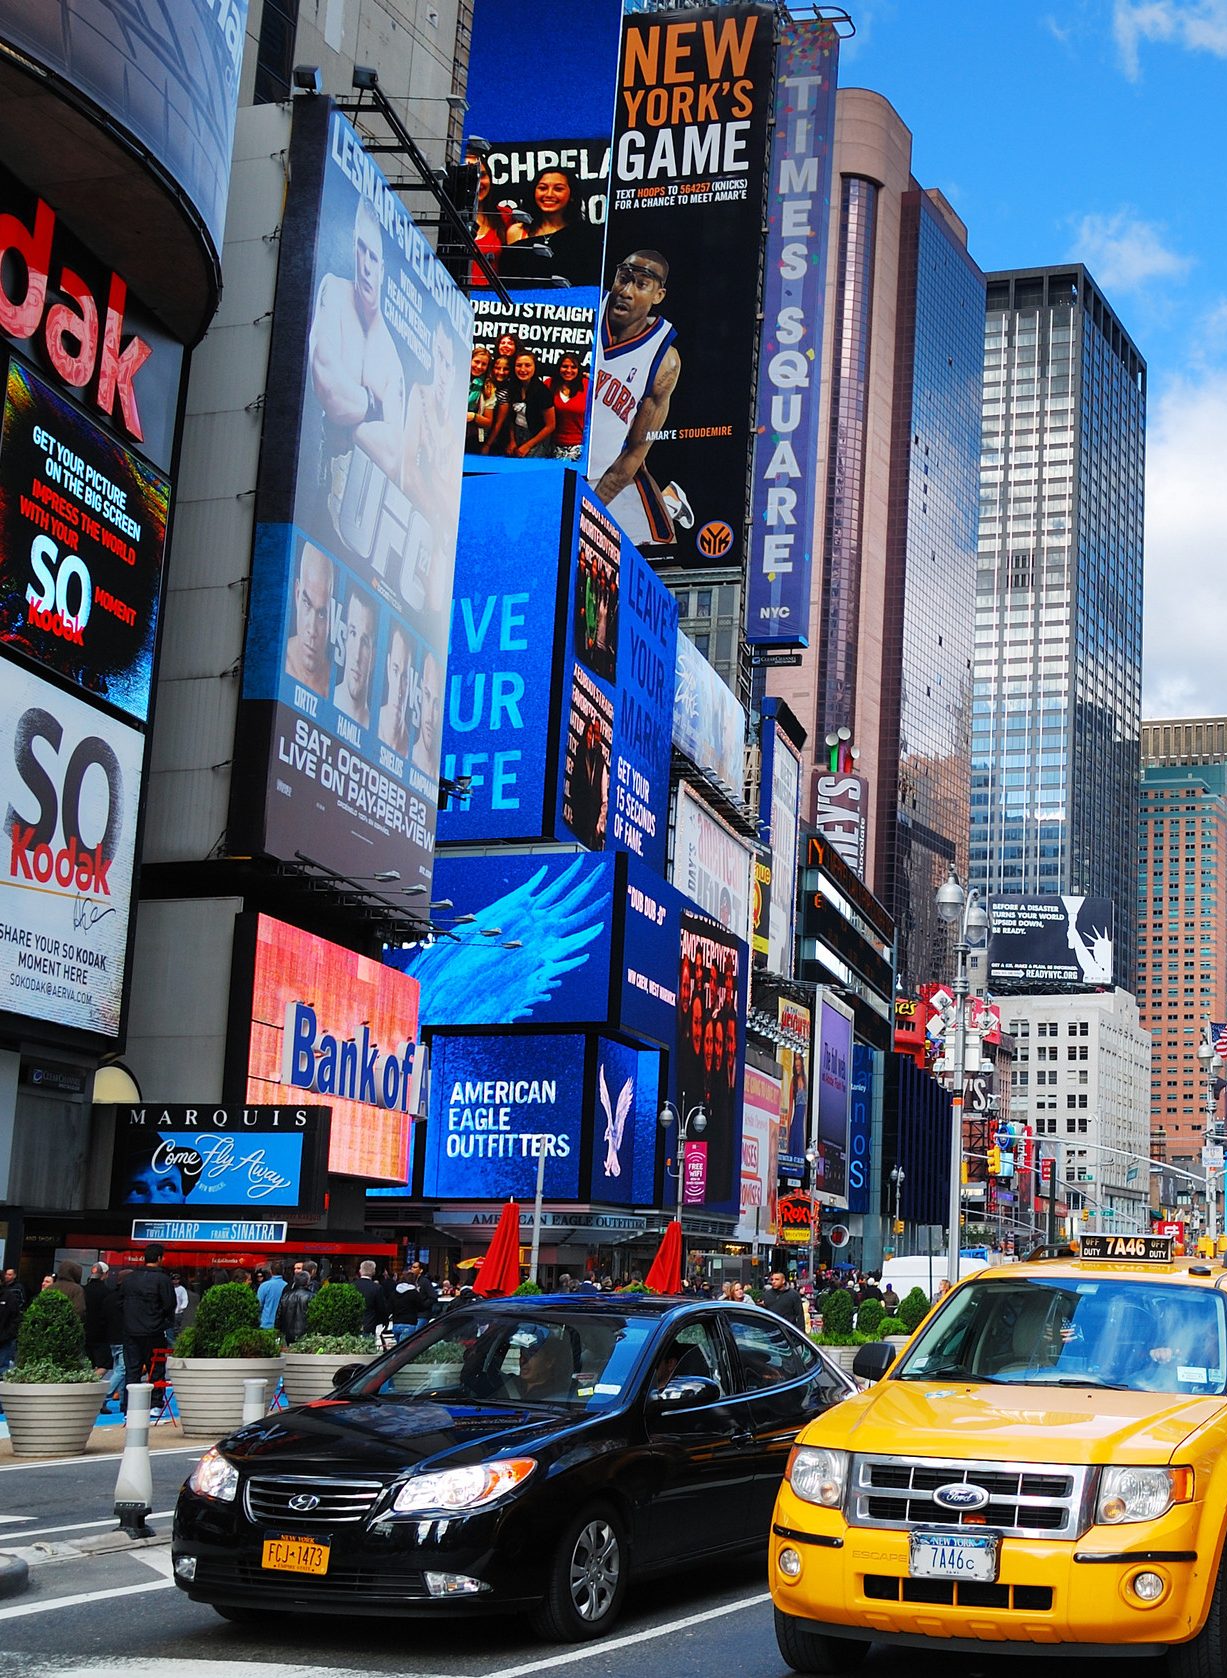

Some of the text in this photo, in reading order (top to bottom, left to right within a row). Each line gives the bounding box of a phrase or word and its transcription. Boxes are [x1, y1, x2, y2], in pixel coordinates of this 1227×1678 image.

[623, 16, 759, 87] NEW
[623, 79, 753, 128] YORK'S
[617, 120, 751, 181] GAME
[331, 115, 394, 239] LESNAR
[615, 190, 748, 210] FOR A CHANCE TO MEET AMAR'E
[616, 179, 748, 199] TEXT HOOPS TO 564257 (KNICKS)
[779, 75, 822, 280] TIMES
[400, 269, 422, 313] WORLD
[403, 216, 473, 348] VELASQUEZ
[387, 277, 432, 349] HEAVYWEIGHT
[595, 369, 637, 425] YORK
[645, 425, 733, 441] AMAR'E STOUDEMIRE
[762, 306, 810, 574] SQUARE
[32, 425, 128, 511] GET YOUR PICTURE
[32, 479, 136, 567] IMPRESS THE WORLD
[45, 458, 141, 543] ON THE BIG SCREEN
[19, 496, 79, 552] WITH YOUR
[26, 534, 91, 631] SO
[628, 556, 667, 648] LEAVE
[27, 596, 85, 647] Kodak
[95, 586, 137, 627] MOMENT
[760, 606, 790, 619] NYC
[330, 598, 346, 668] VS
[630, 627, 665, 702] YOUR
[294, 684, 319, 719] ORTIZ
[409, 663, 423, 728] VS
[450, 671, 525, 733] UR
[336, 714, 361, 749] HAMILL
[619, 687, 664, 762] MARK
[278, 737, 316, 780] LIVE
[320, 765, 345, 798] ON
[294, 718, 332, 763] SAT.
[337, 750, 406, 810] OCTOBER
[409, 797, 427, 827] 23
[379, 745, 404, 779] SHIELDS
[618, 756, 650, 804] GET YOUR
[3, 707, 124, 866] SO
[613, 813, 644, 857] OF FAME.
[616, 786, 656, 838] 15 SECONDS
[10, 823, 111, 895] Kodak
[992, 903, 1019, 911] BEFORE
[1028, 904, 1060, 913] DISASTER
[992, 911, 1065, 921] TURNS YOUR WORLD
[992, 919, 1044, 929] UPSIDE DOWN,
[0, 923, 107, 971] SHARE YOUR SO KODAK
[1002, 928, 1027, 936] READY.
[10, 973, 92, 1005] SOKODAK@AERVA.COM
[18, 950, 89, 986] MOMENT HERE
[1026, 969, 1078, 980] READYNYC.ORG
[286, 1001, 415, 1112] Bank of
[449, 1080, 557, 1105] AMERICAN
[130, 1109, 308, 1126] MARQUIS
[448, 1107, 511, 1131] EAGLE
[151, 1134, 292, 1199] Come Fly Away
[446, 1133, 571, 1158] OUTFITTERS
[688, 1163, 704, 1171] FREE
[146, 1221, 276, 1241] TWYLA THARP FRANK SINATRA
[552, 1215, 646, 1229] EAGLE OUTFITTERS
[1083, 1247, 1167, 1259] DUTY DUTY
[1085, 1237, 1165, 1257] OFF 7A46 OFF
[946, 1489, 973, 1504] Ford
[297, 1535, 316, 1544] YORK
[851, 1550, 908, 1563] ESCAPE
[931, 1537, 975, 1548] NEW YORK
